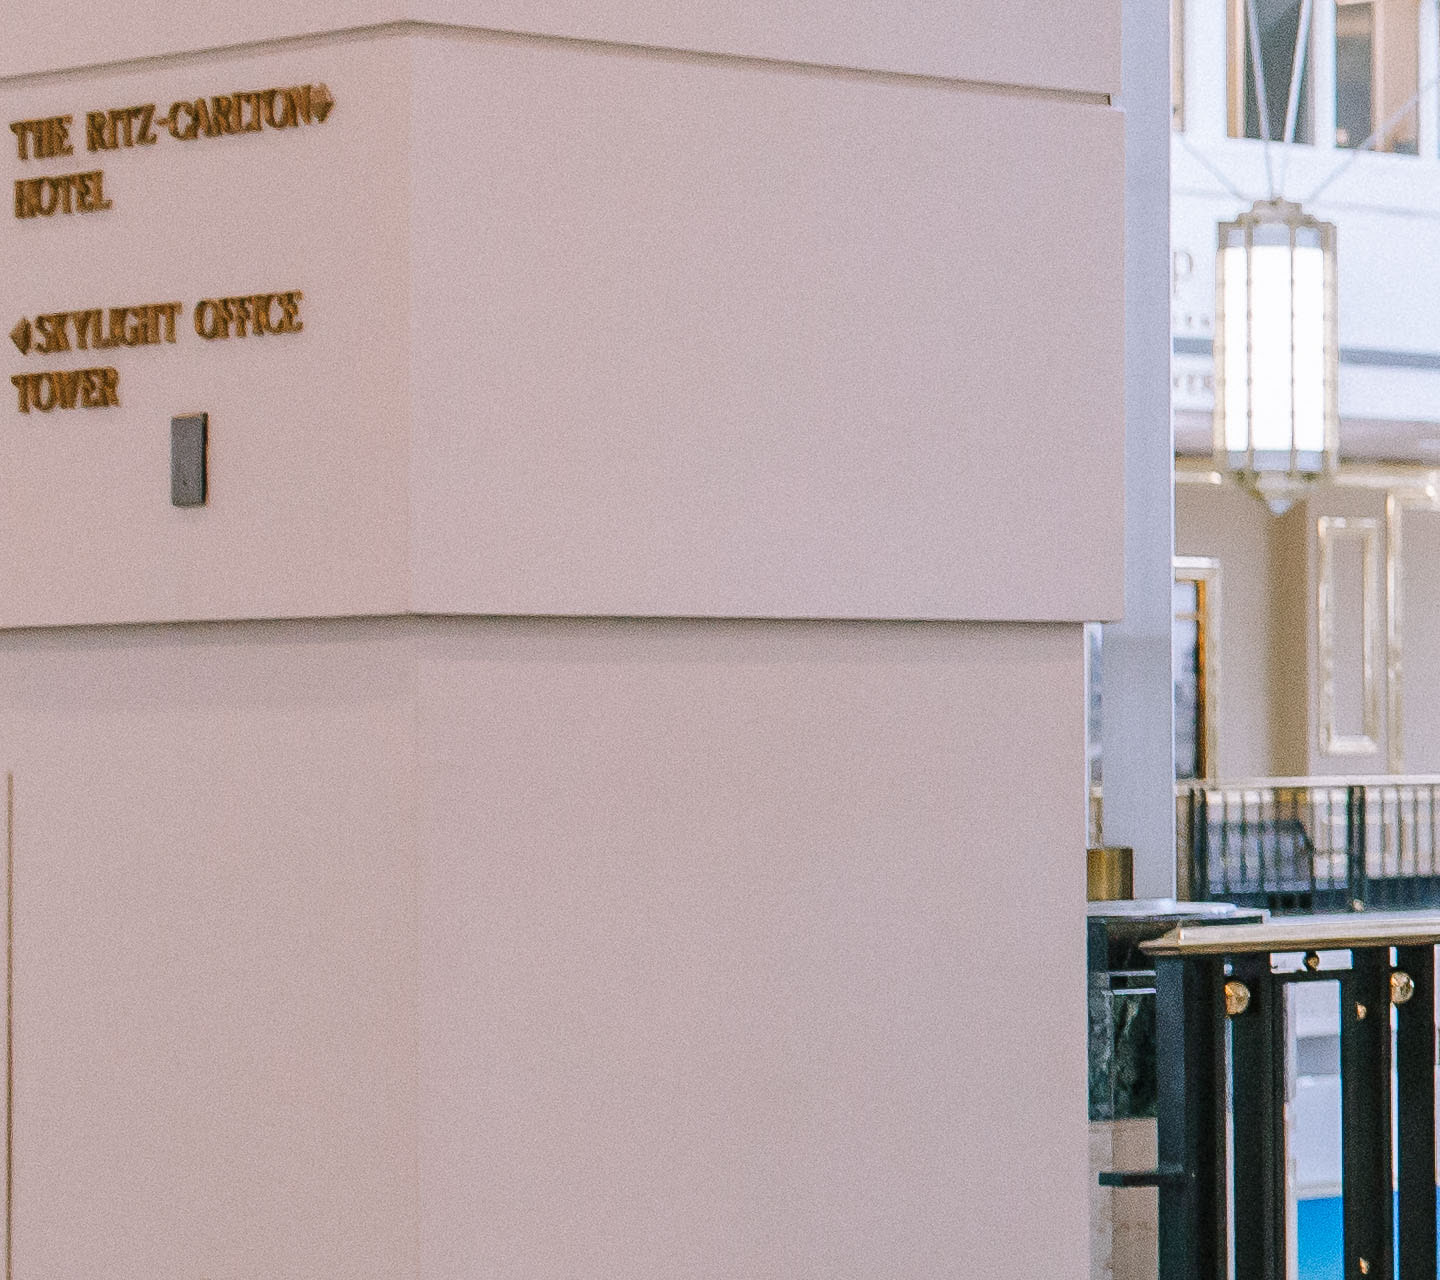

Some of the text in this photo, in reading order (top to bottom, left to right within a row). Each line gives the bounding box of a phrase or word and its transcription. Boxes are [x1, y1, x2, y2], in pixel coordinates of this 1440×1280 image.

[9, 84, 313, 161] THE RITZ-CARLTON
[13, 169, 113, 220] HOTEL
[35, 289, 304, 355] SKYLIGHT OFFICE
[9, 366, 120, 415] TOWER
